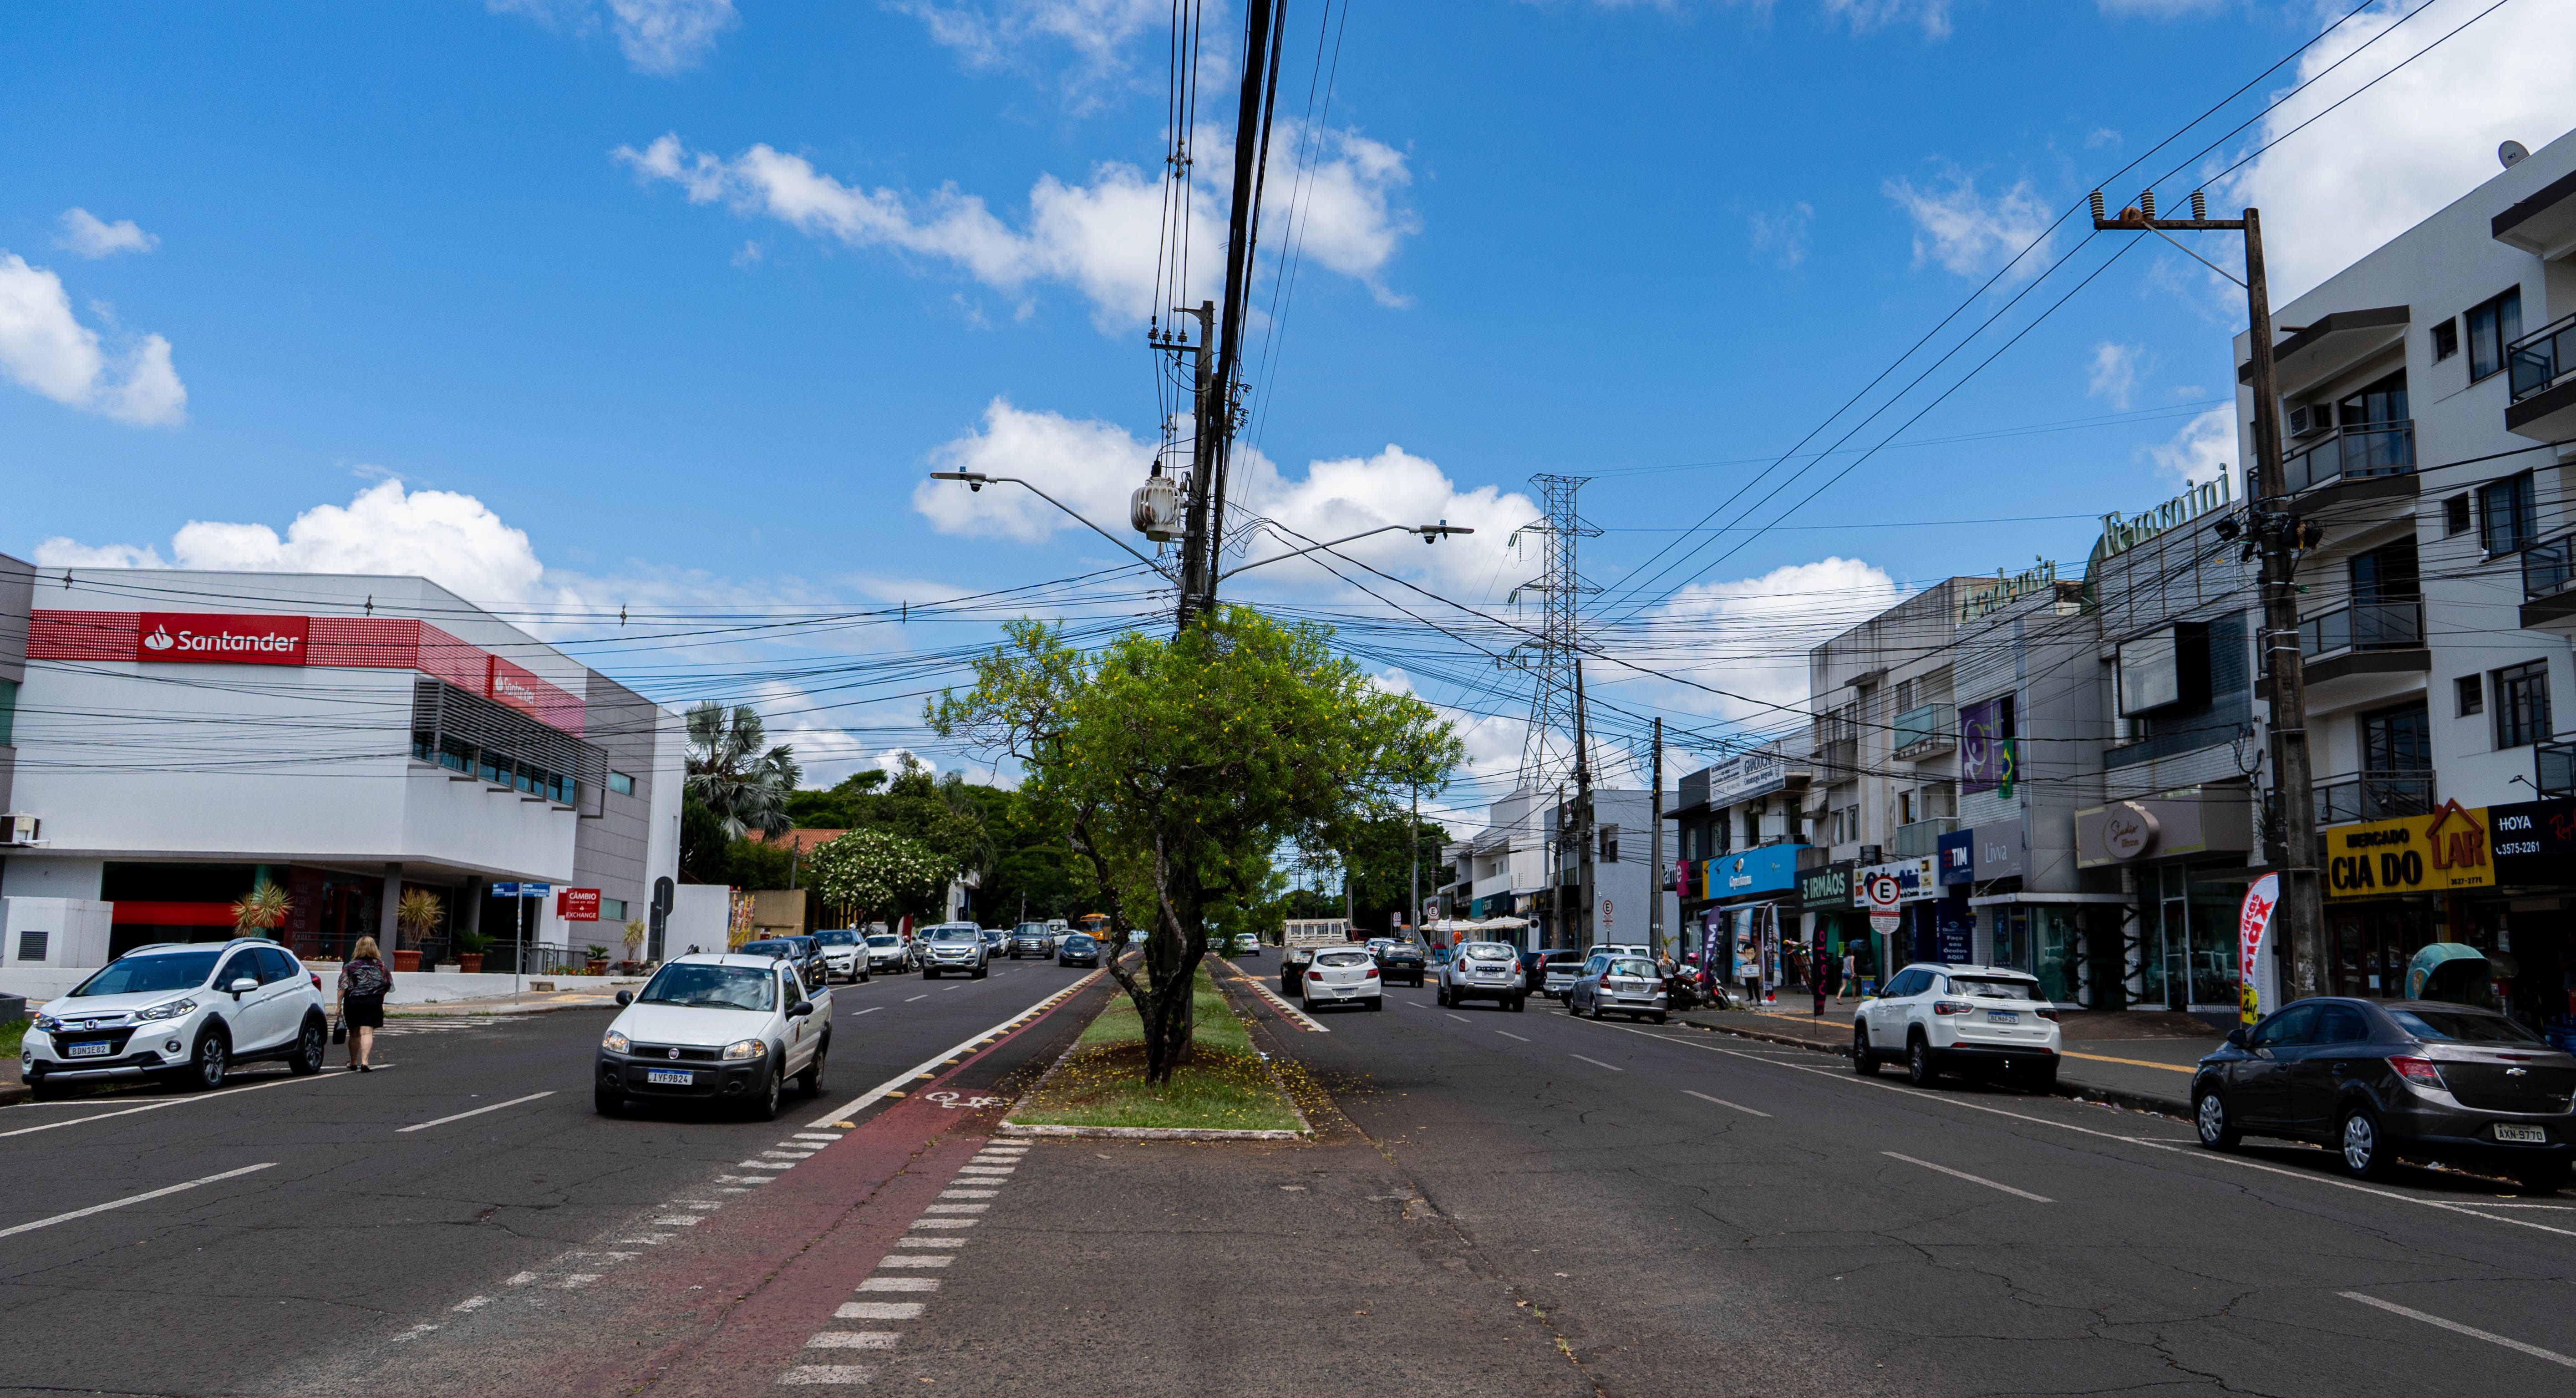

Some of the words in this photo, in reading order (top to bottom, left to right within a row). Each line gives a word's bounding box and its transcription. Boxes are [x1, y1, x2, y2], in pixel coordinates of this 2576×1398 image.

[1962, 554, 2056, 624] Academia
[177, 630, 299, 652] Santander
[504, 677, 534, 705] Santander
[2498, 815, 2532, 831] HOYA
[2346, 828, 2410, 848] MERCADO
[1952, 847, 1967, 867] TIM
[2502, 841, 2540, 855] 3575-2261
[2331, 854, 2375, 890] CIA
[2381, 850, 2423, 886] DO
[2431, 830, 2486, 869] LAR
[1802, 879, 1808, 900] 3
[1809, 868, 1845, 899] IRMÃOS
[1880, 882, 1891, 899] E
[569, 891, 596, 900] CÂMBIO
[1606, 903, 1610, 912] E
[1706, 924, 1717, 963] TIM
[72, 1046, 106, 1055] BDN1E82
[653, 1073, 687, 1083] IYF9B24
[2500, 1129, 2543, 1140] AXN-9770
